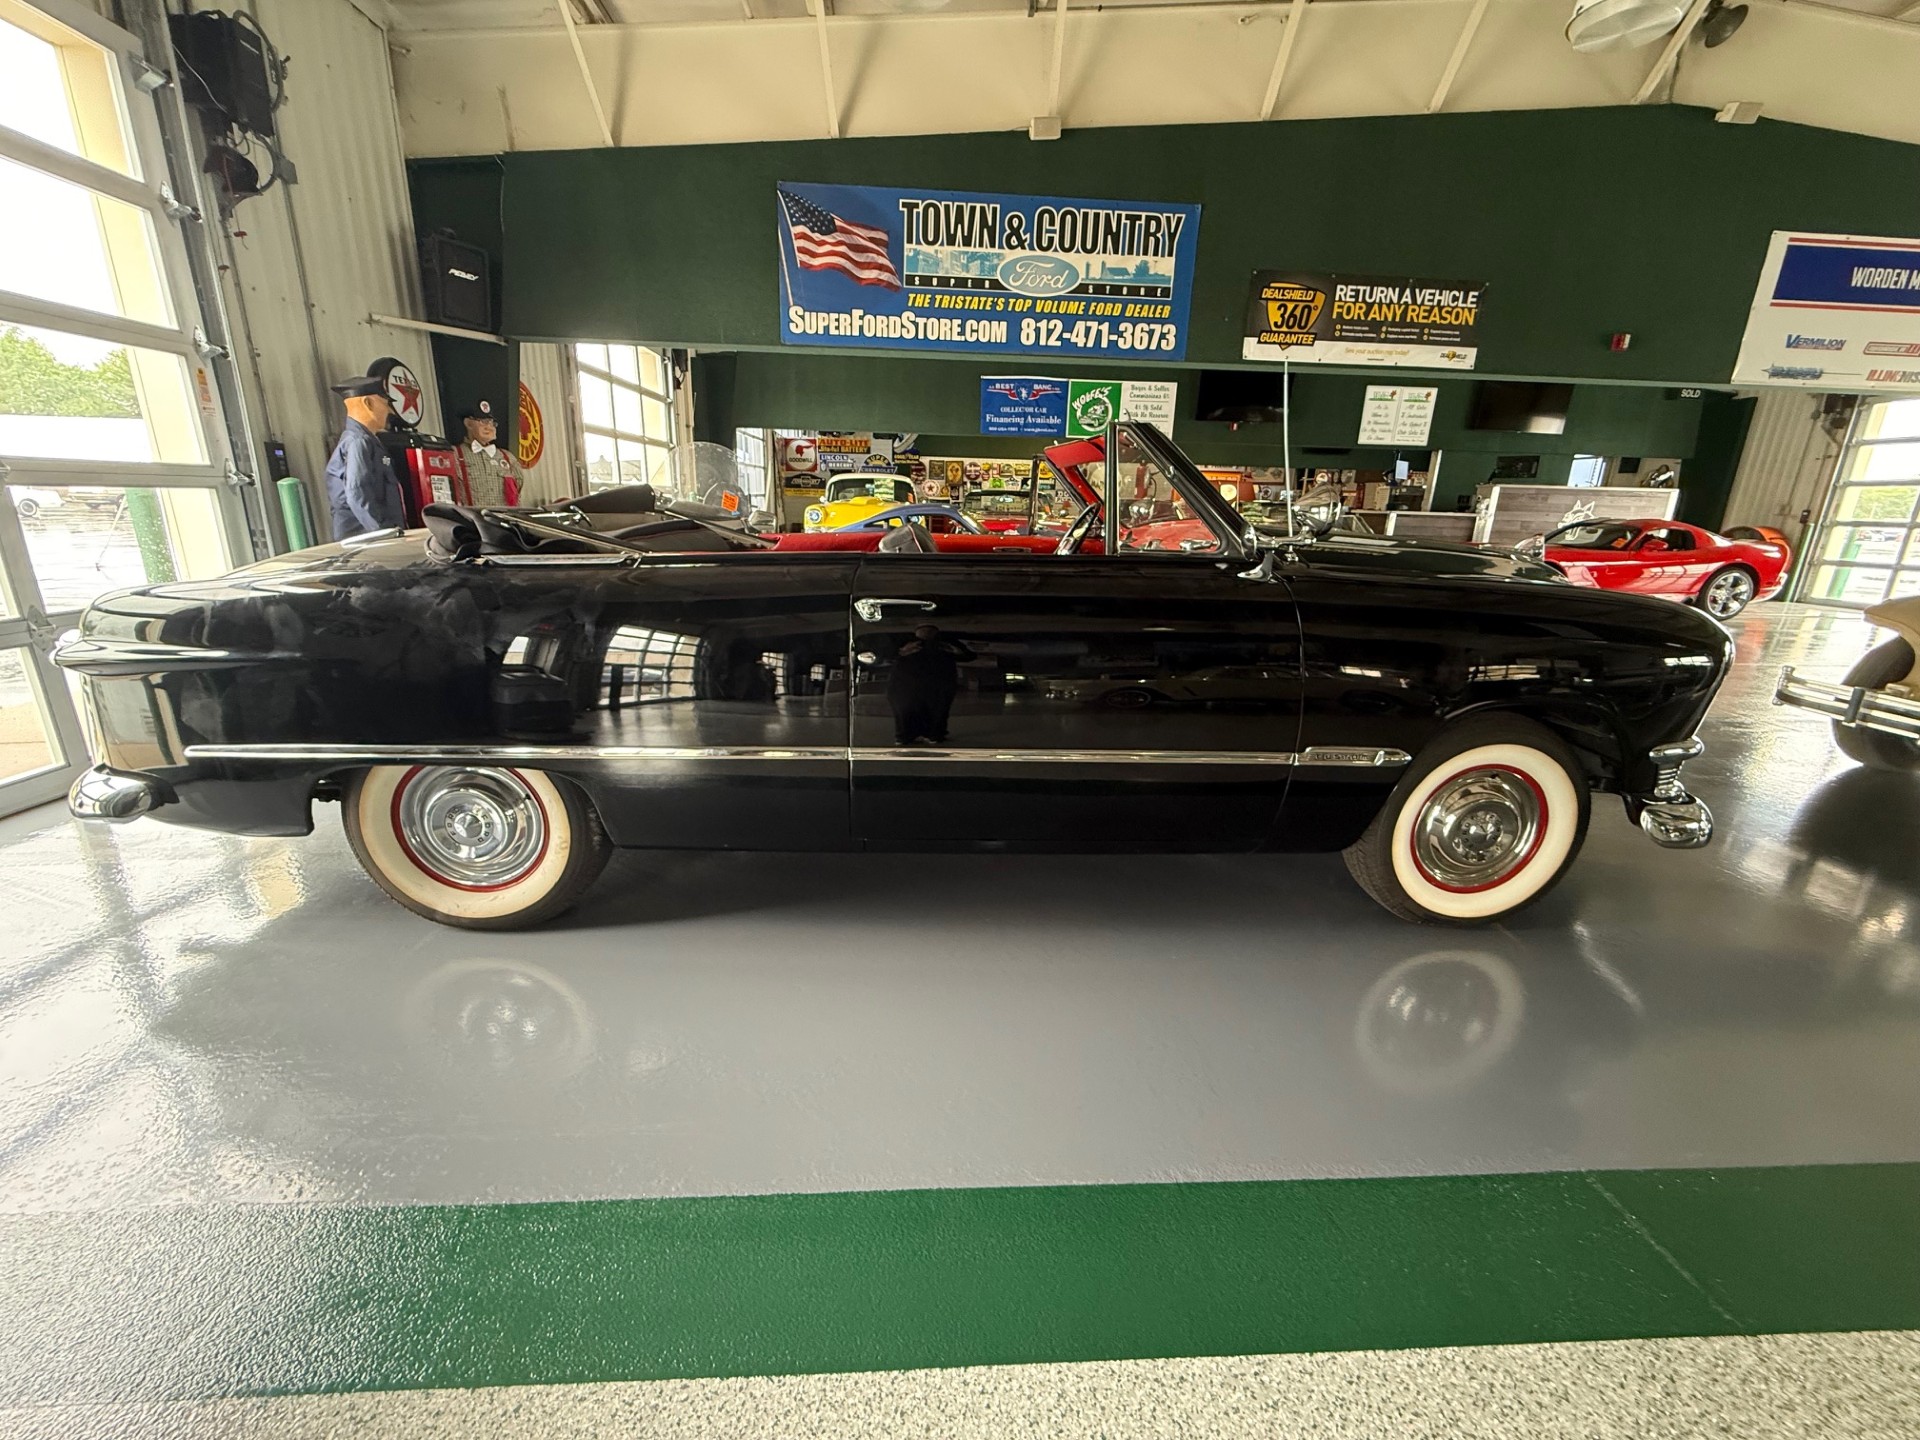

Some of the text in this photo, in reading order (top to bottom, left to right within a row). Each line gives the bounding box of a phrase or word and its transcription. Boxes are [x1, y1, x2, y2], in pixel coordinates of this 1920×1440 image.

[899, 198, 1186, 258] TOWN & COUNTRY
[1008, 259, 1070, 290] Ford
[1851, 266, 1910, 290] WORDEN
[914, 276, 1163, 297] SUPER STORE
[1261, 287, 1315, 301] DEALSHIELD
[1334, 284, 1479, 308] RETURN A VEHICLE
[907, 293, 1171, 319] THE TRISTATE'S TOP VOLUME FORD DEALER
[1332, 301, 1476, 327] FOR ANY REASON
[1020, 317, 1177, 351] 812-471-3673
[1259, 332, 1316, 346] GUARANTEE
[1785, 333, 1847, 350] VERMILION
[392, 374, 418, 389] TEXCO
[1681, 389, 1701, 398] SOLD
[985, 413, 1062, 426] Financing Available
[819, 438, 869, 447] AUTO-LITE
